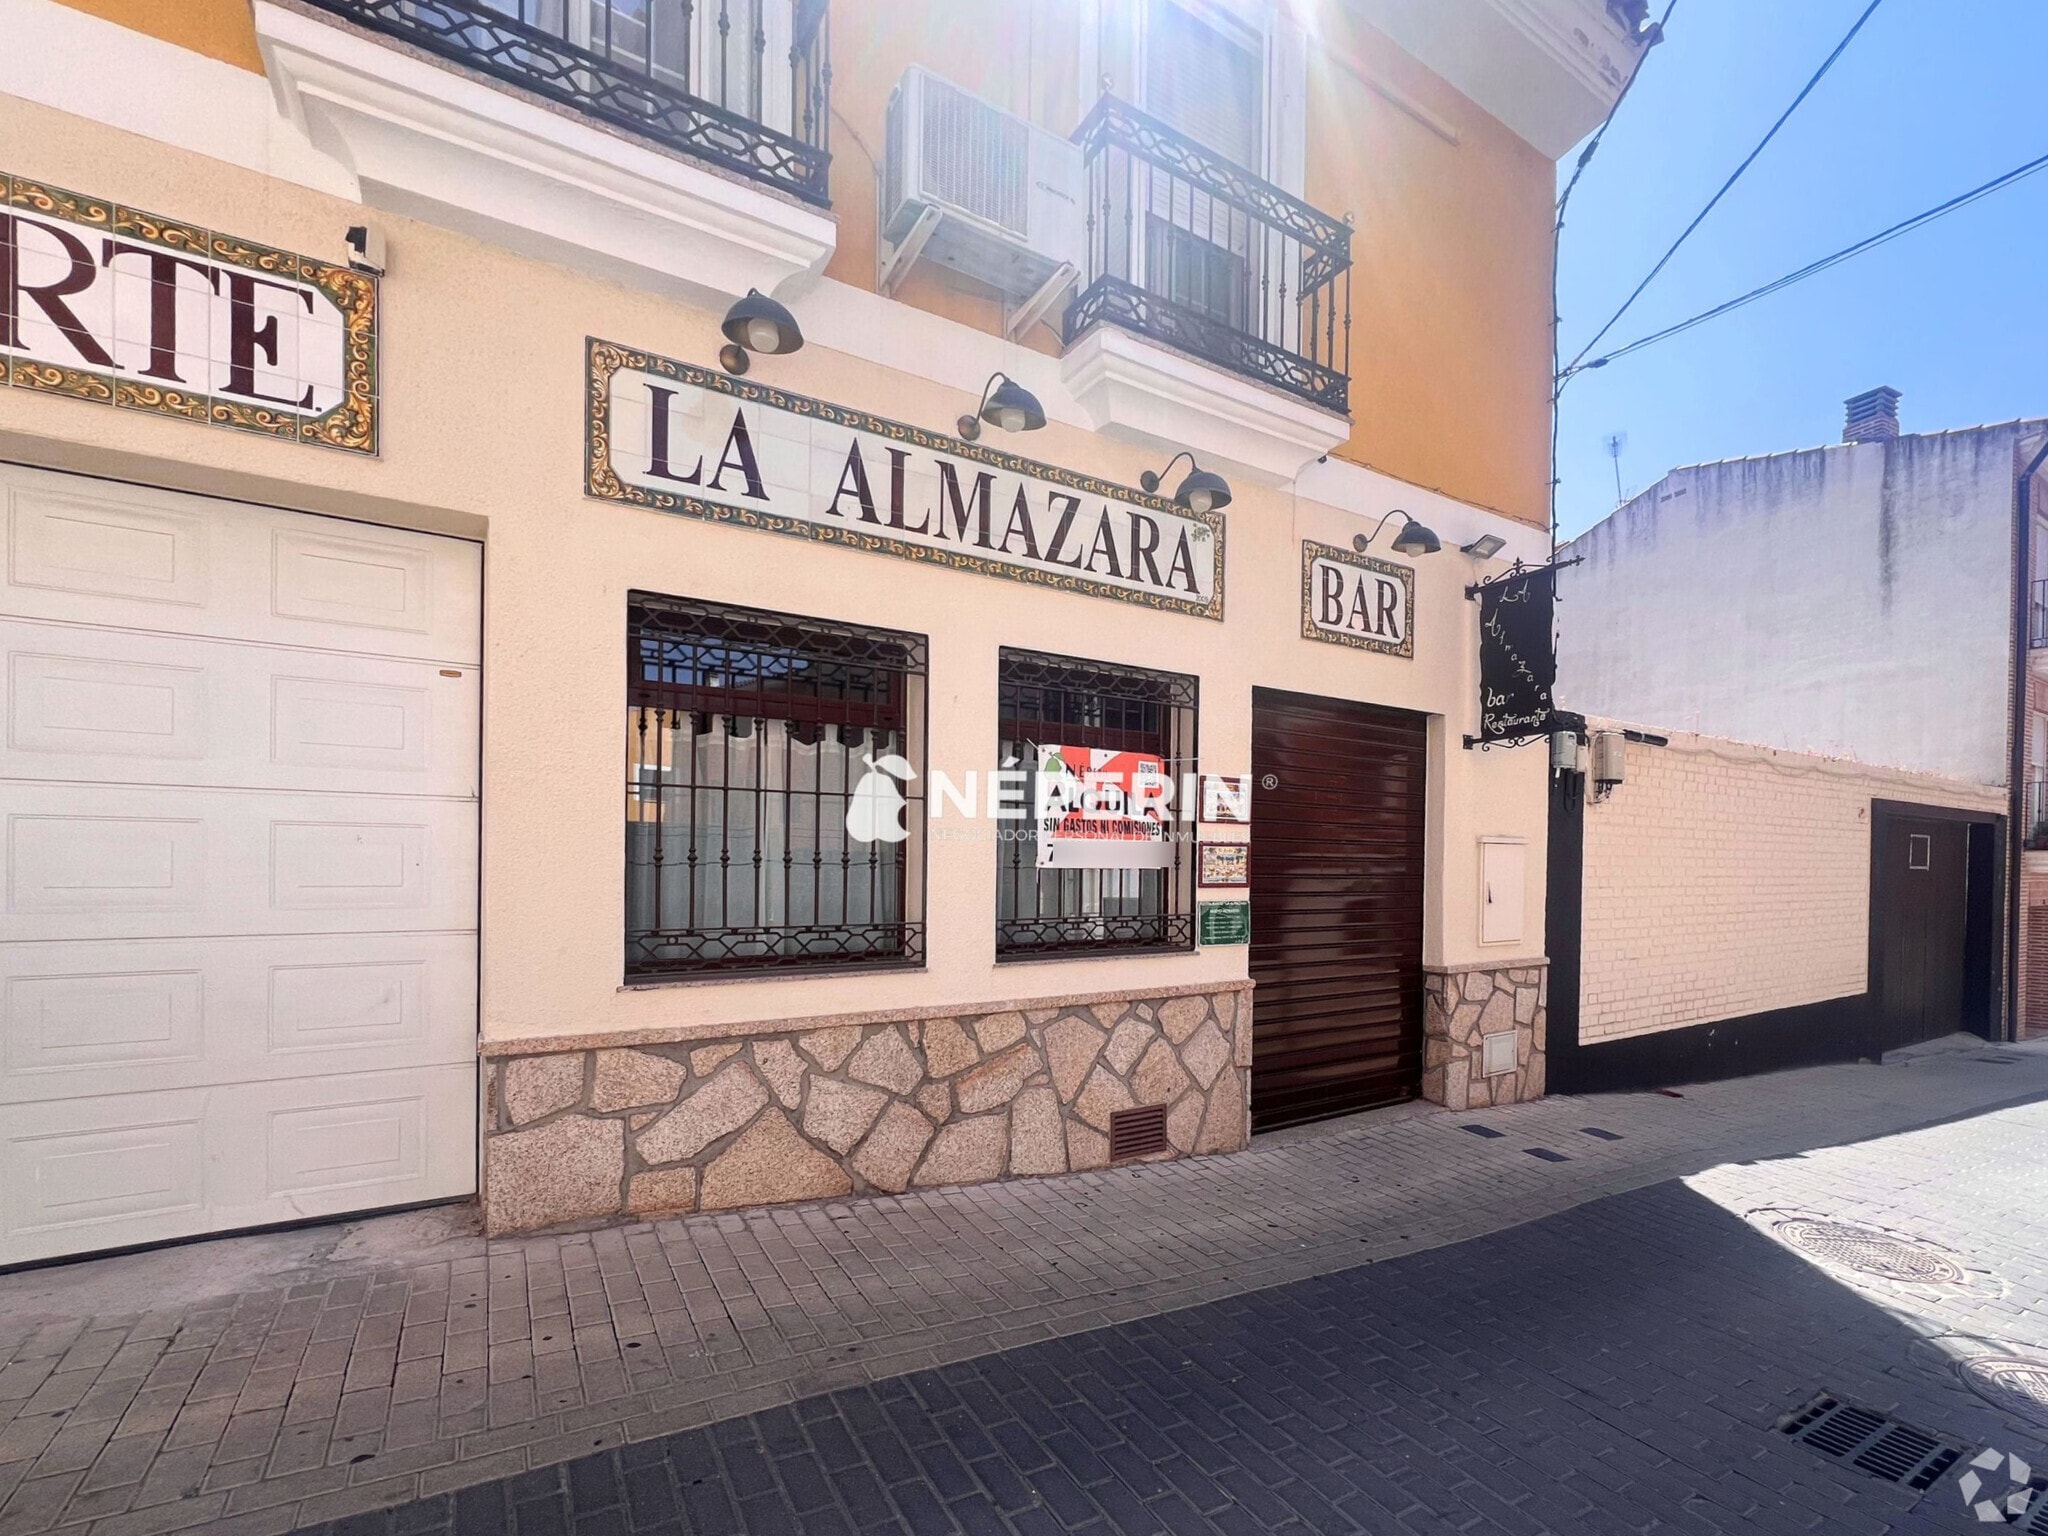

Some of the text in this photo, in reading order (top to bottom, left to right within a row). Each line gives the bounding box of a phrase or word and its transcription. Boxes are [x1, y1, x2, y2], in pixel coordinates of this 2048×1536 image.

[642, 383, 1200, 594] LA ALMAZARA
[1318, 564, 1400, 639] BAR
[1486, 687, 1514, 707] bar
[1043, 817, 1161, 836] SIN GASTOS NI COMISIONES
